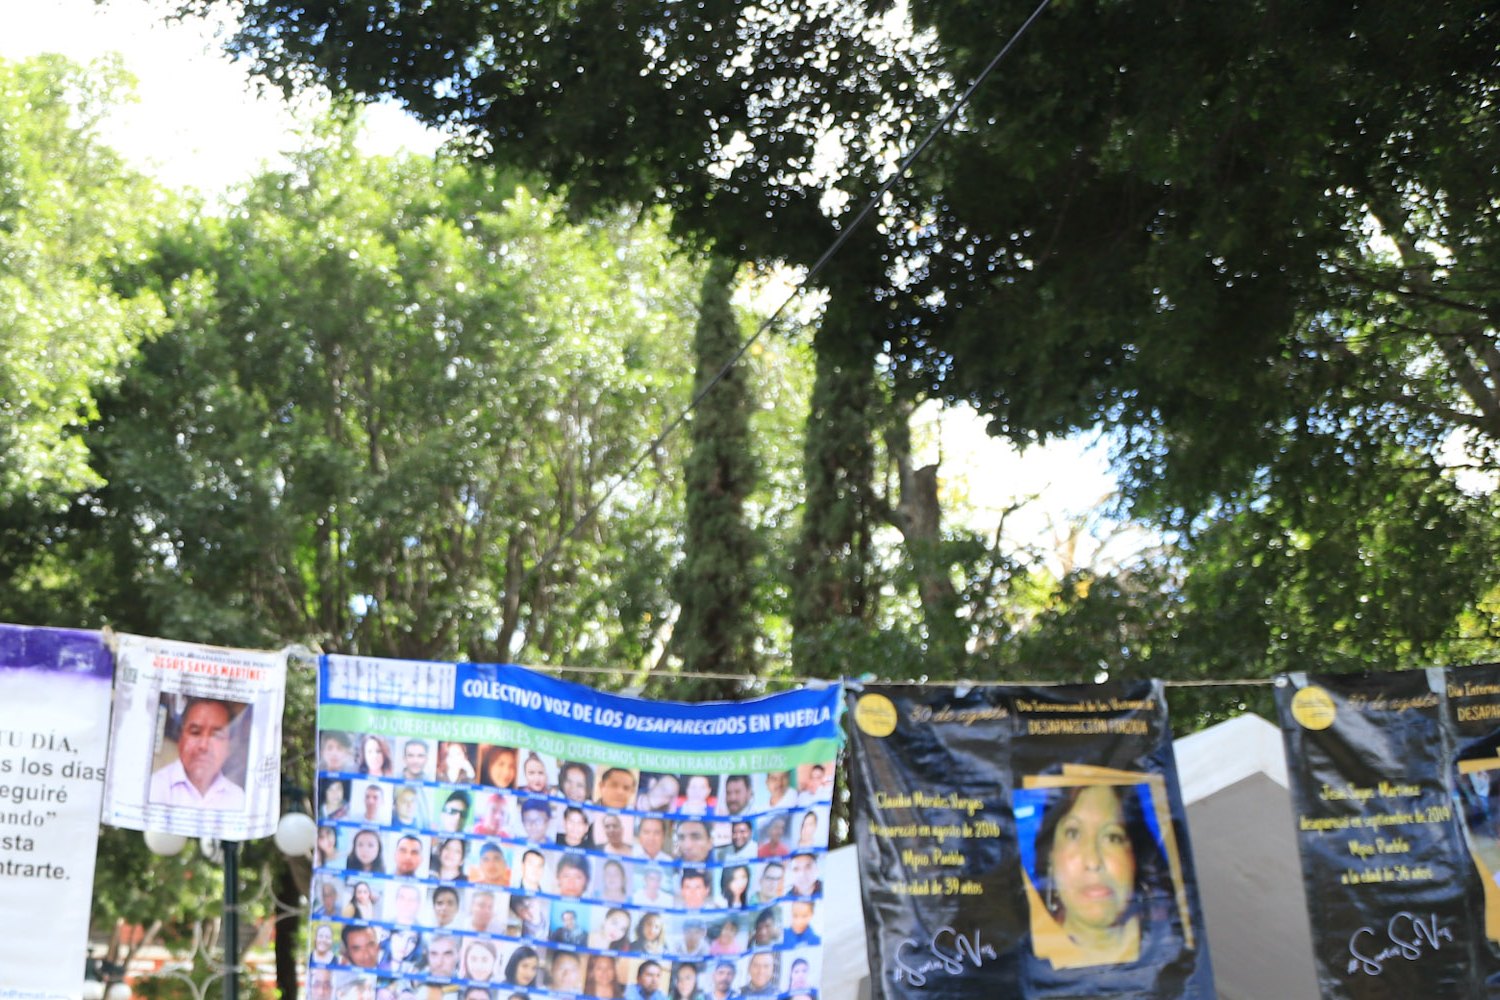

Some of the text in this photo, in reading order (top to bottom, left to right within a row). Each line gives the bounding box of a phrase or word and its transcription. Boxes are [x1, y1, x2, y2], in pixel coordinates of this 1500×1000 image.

[462, 679, 542, 710] COLECTIVO
[543, 695, 571, 717] VOZ
[572, 702, 593, 723] DE
[594, 707, 623, 727] LOS
[624, 713, 746, 735] DESAPARECIDOS
[750, 714, 771, 733] EN
[773, 706, 830, 730] PUEBLA
[31, 729, 78, 754] DÍA,
[370, 715, 387, 730] NO
[389, 718, 459, 738] QUEREMOS
[462, 720, 534, 747] CULPABLES,
[568, 740, 635, 763] QUEREMOS
[638, 752, 735, 770] ENCONTRARLOS
[739, 756, 748, 768] A
[751, 754, 786, 769] ELLOS:
[21, 756, 53, 776] los
[61, 760, 106, 782] días
